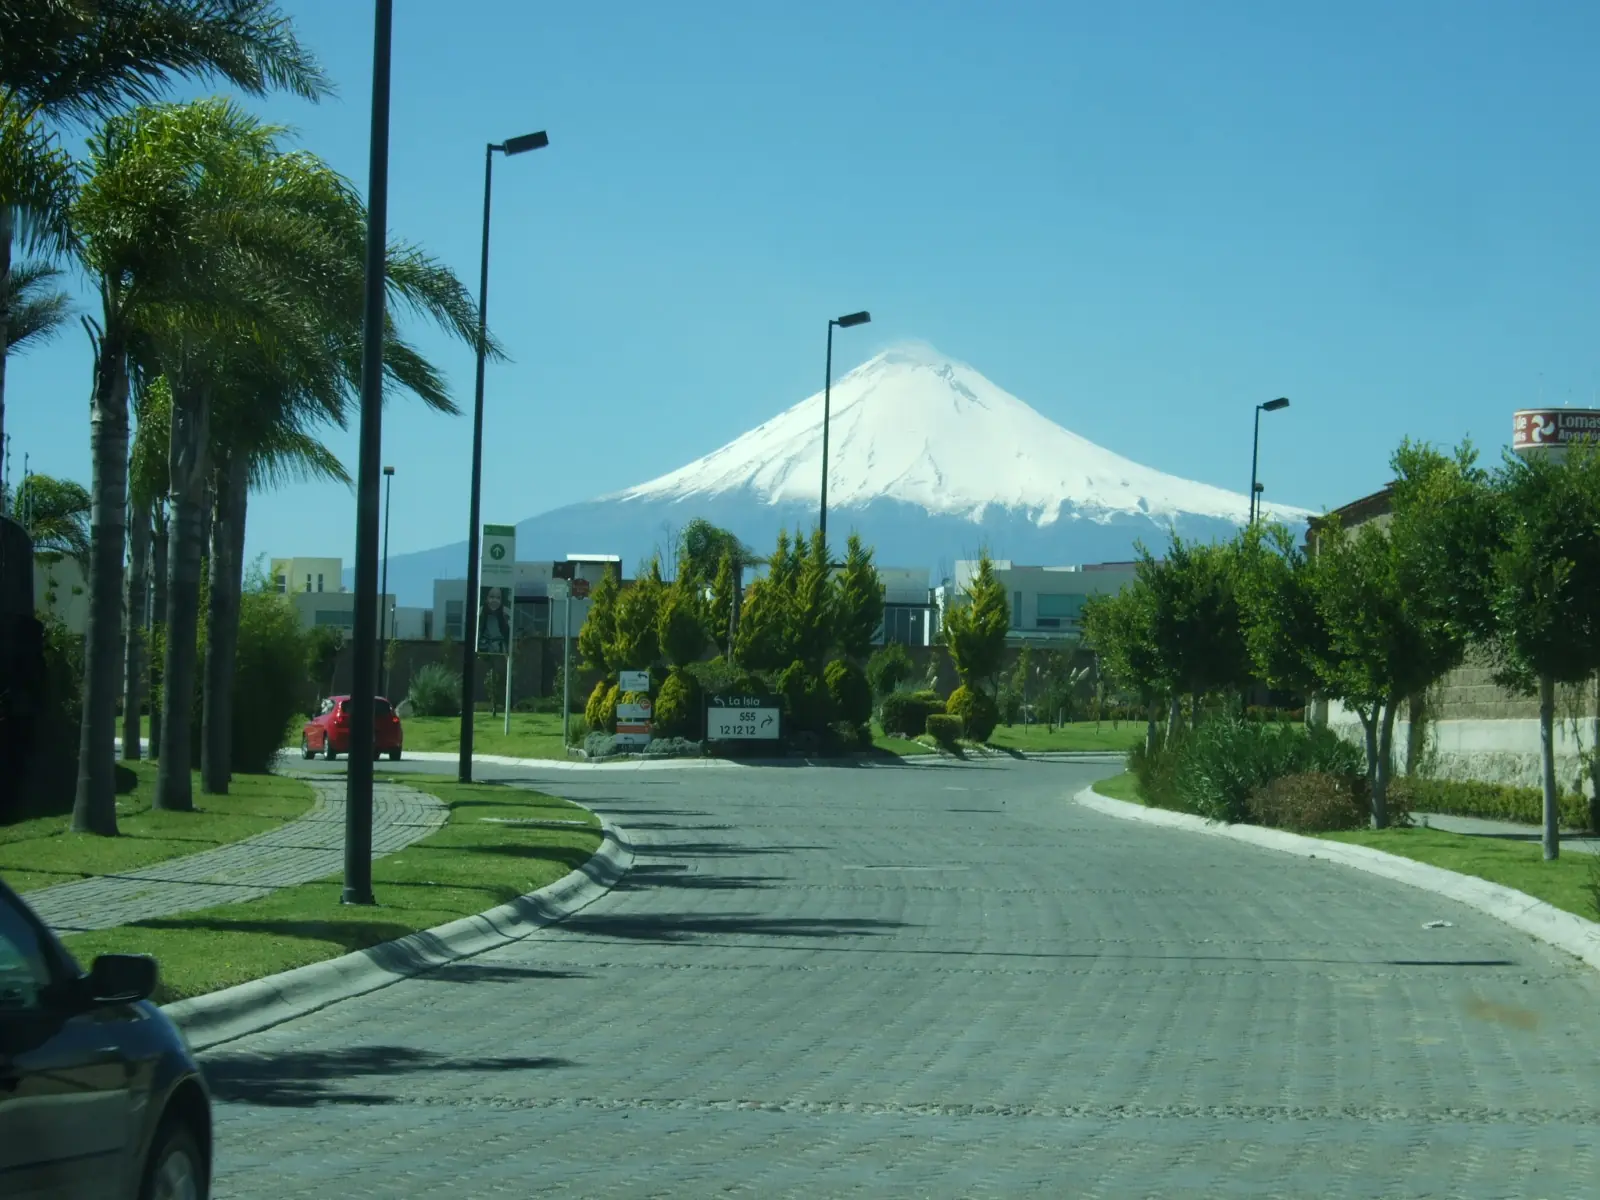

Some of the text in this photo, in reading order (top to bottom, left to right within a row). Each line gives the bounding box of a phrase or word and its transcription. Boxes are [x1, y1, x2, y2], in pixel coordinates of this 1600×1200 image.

[1558, 413, 1600, 429] Lomas
[729, 696, 760, 706] La Isla
[740, 712, 756, 722] 555
